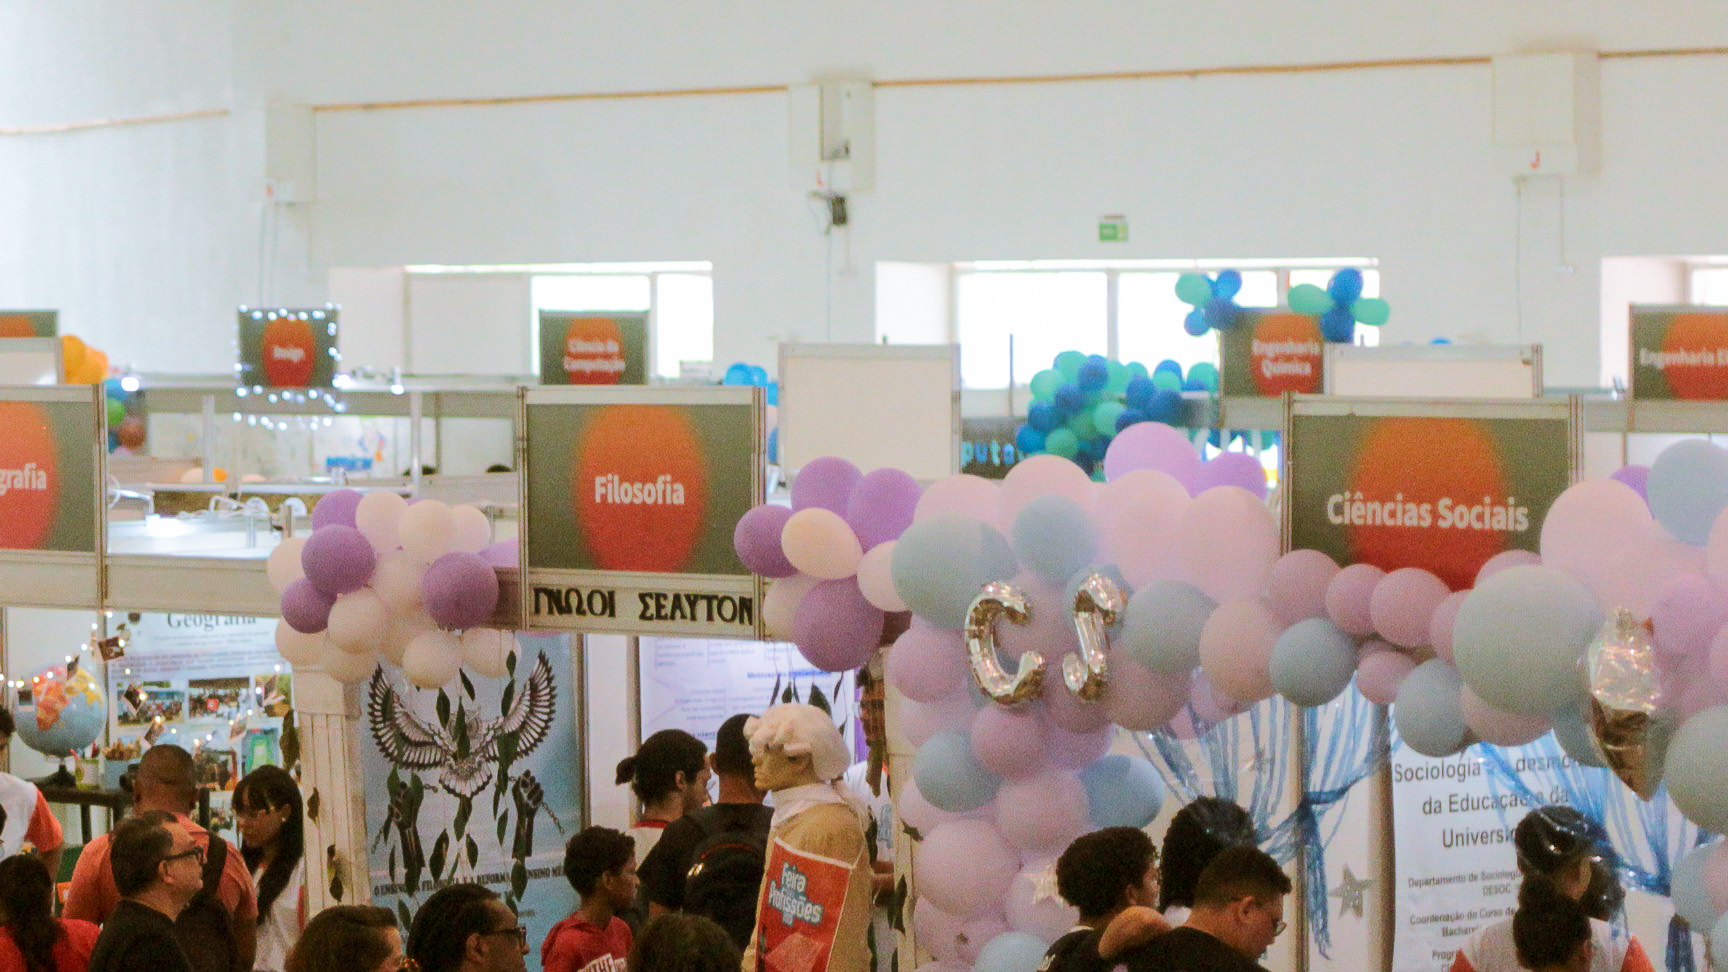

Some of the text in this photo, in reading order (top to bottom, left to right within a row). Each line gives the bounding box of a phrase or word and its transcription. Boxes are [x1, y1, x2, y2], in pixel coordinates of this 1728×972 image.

[594, 474, 685, 505] Filosofia
[1327, 491, 1529, 531] Ciências Sociais
[1394, 759, 1481, 783] Sociologia
[1422, 796, 1441, 815] da
